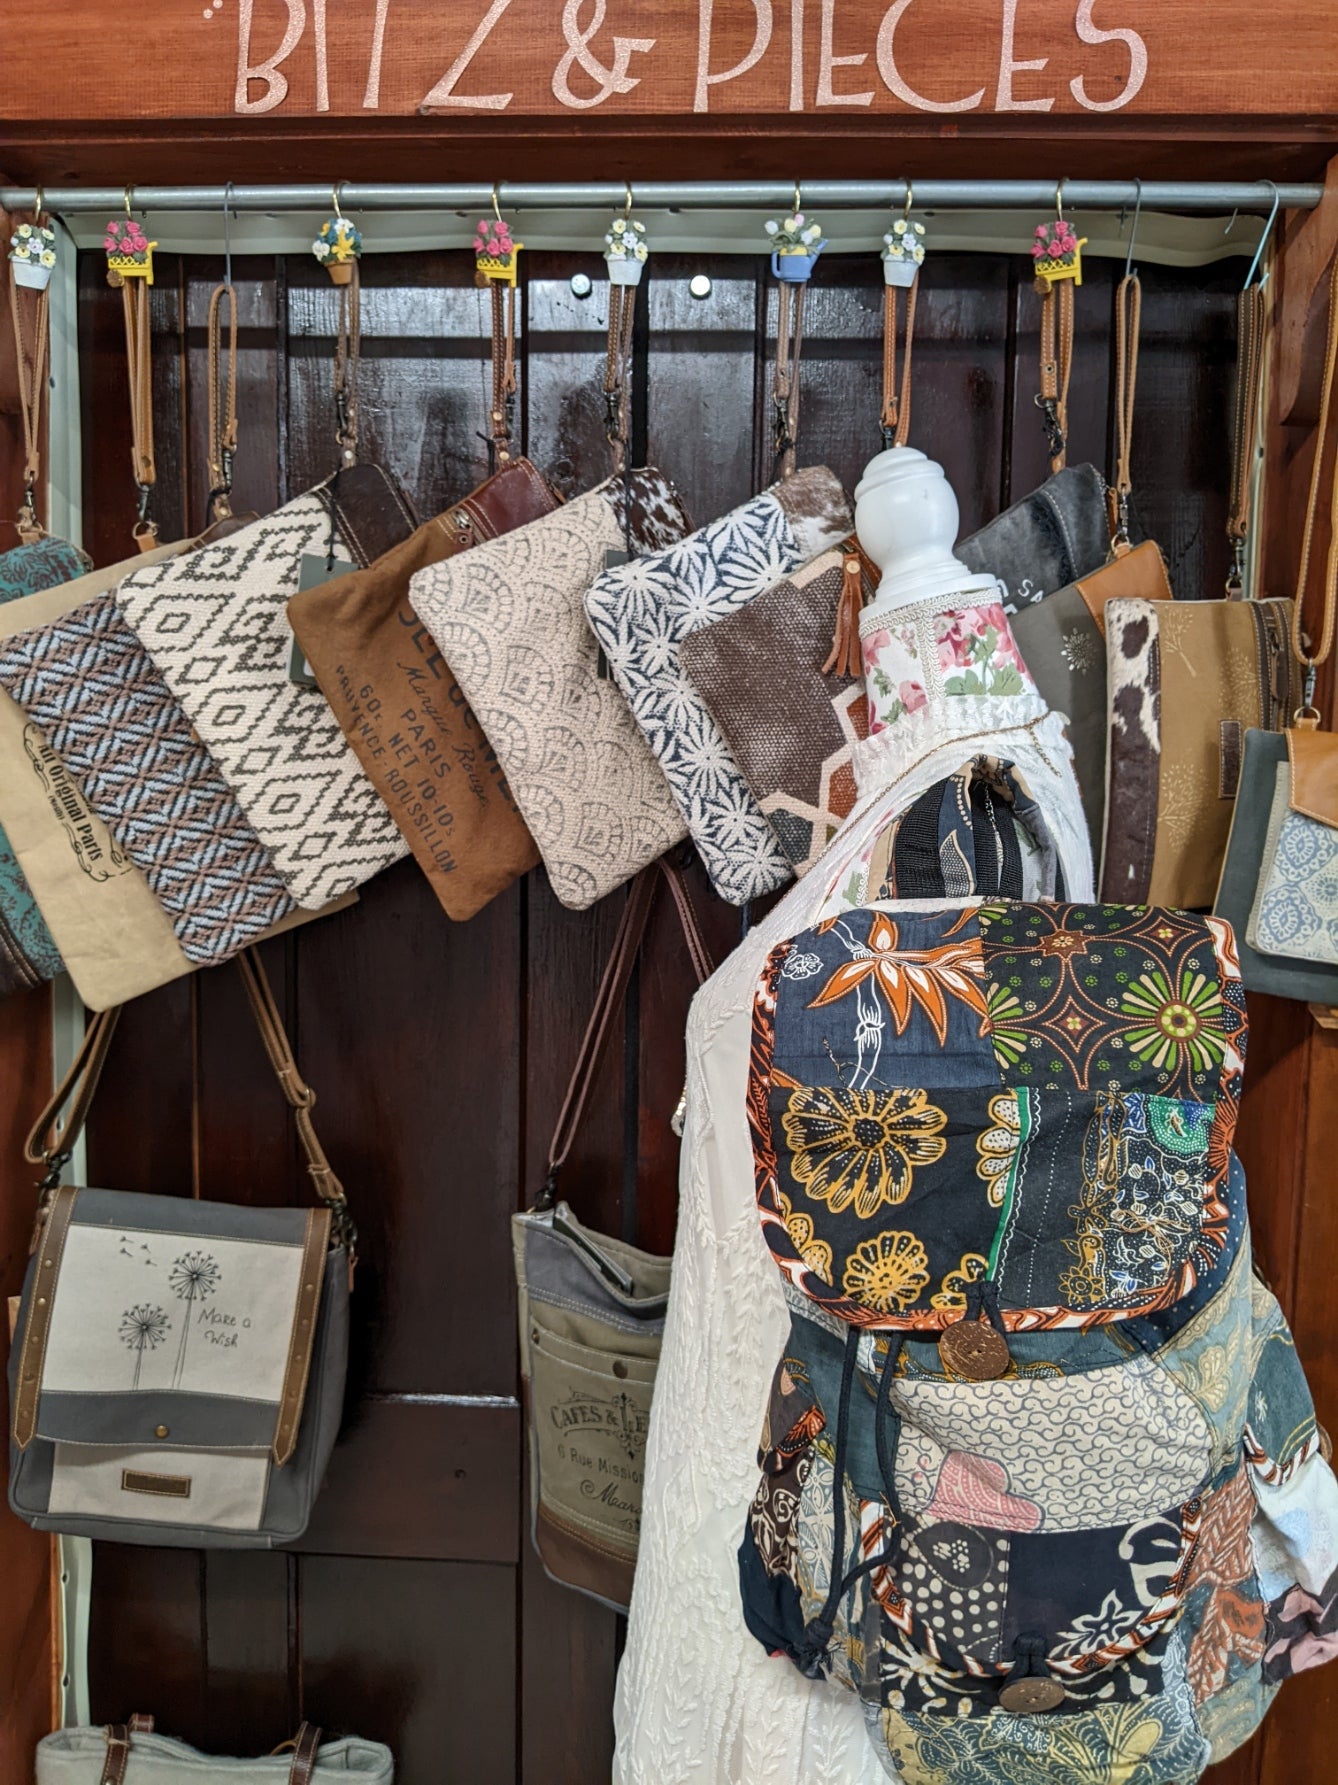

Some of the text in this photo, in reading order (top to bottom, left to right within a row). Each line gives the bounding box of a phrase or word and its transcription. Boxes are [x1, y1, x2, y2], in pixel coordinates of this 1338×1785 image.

[693, 0, 1148, 113] PIECES
[388, 732, 420, 769] NET
[400, 708, 452, 779] PARIS
[48, 764, 88, 823] Original
[76, 823, 104, 862] Parts
